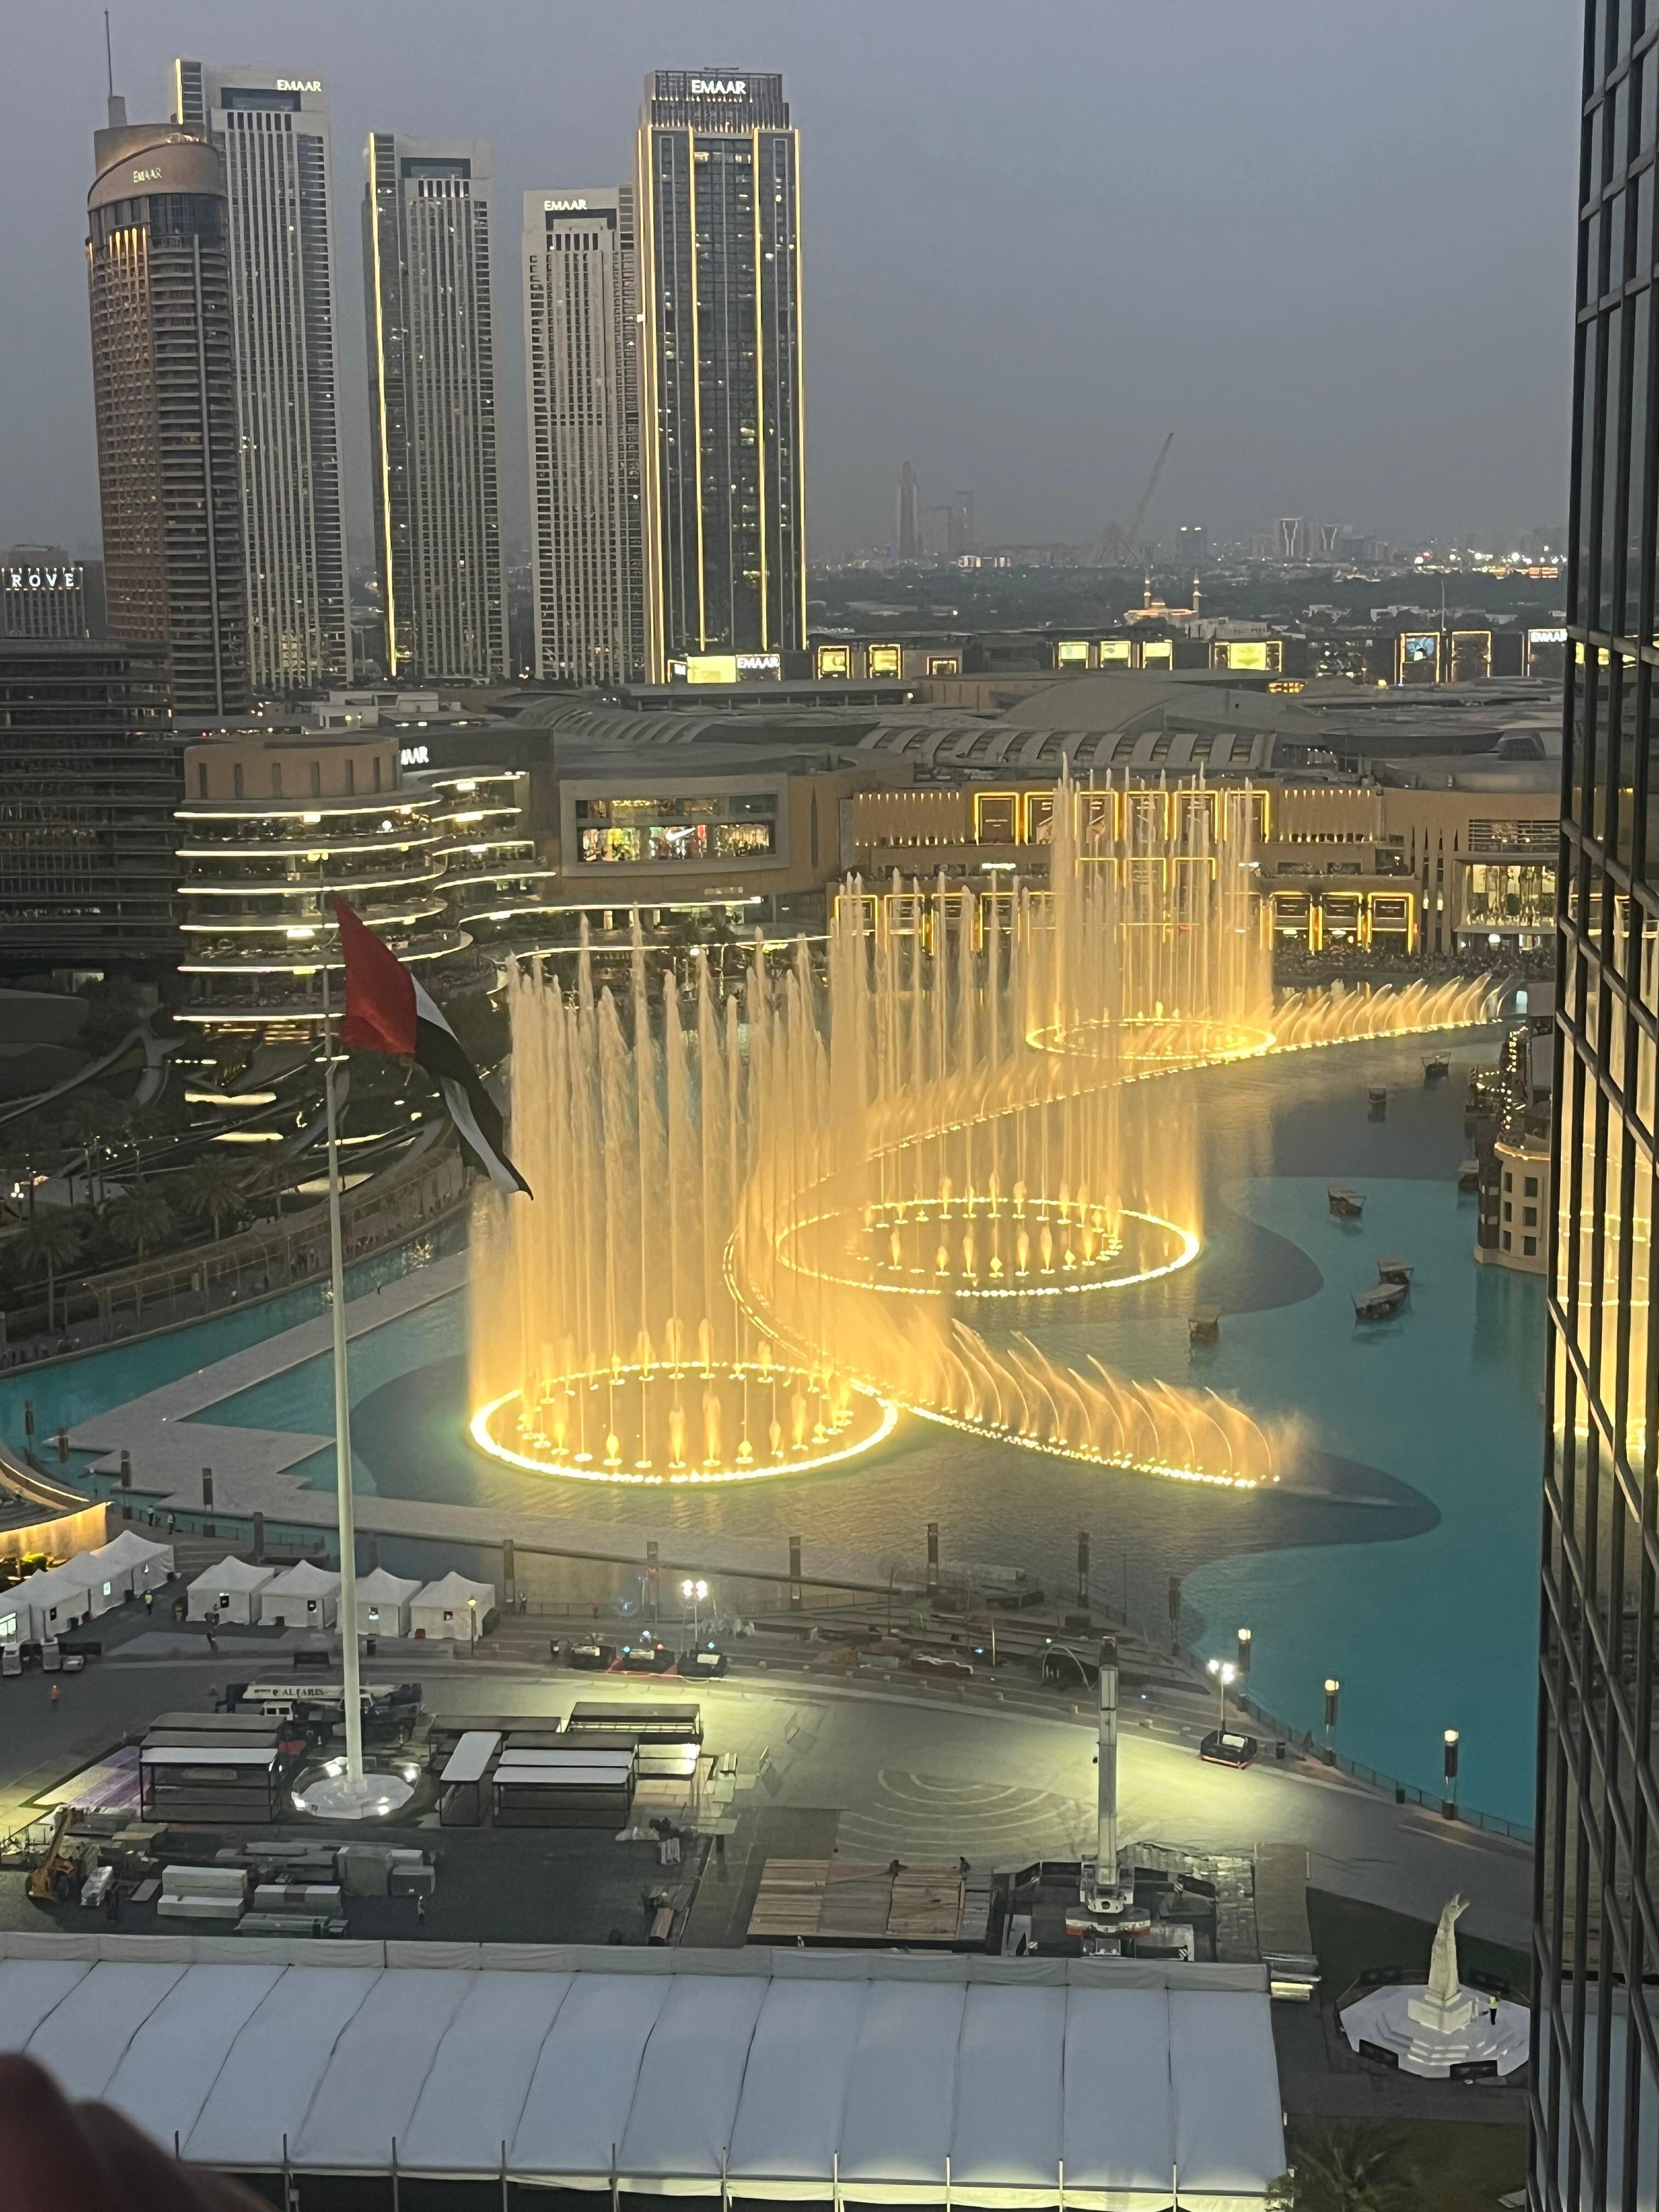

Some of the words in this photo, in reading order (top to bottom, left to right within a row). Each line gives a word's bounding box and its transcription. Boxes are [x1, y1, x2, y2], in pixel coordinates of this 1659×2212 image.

[277, 80, 321, 92] EMAAR
[692, 80, 747, 94] EMAAR
[544, 199, 588, 211] EMAAR
[11, 573, 75, 588] ROVE
[737, 657, 780, 669] EMAAR
